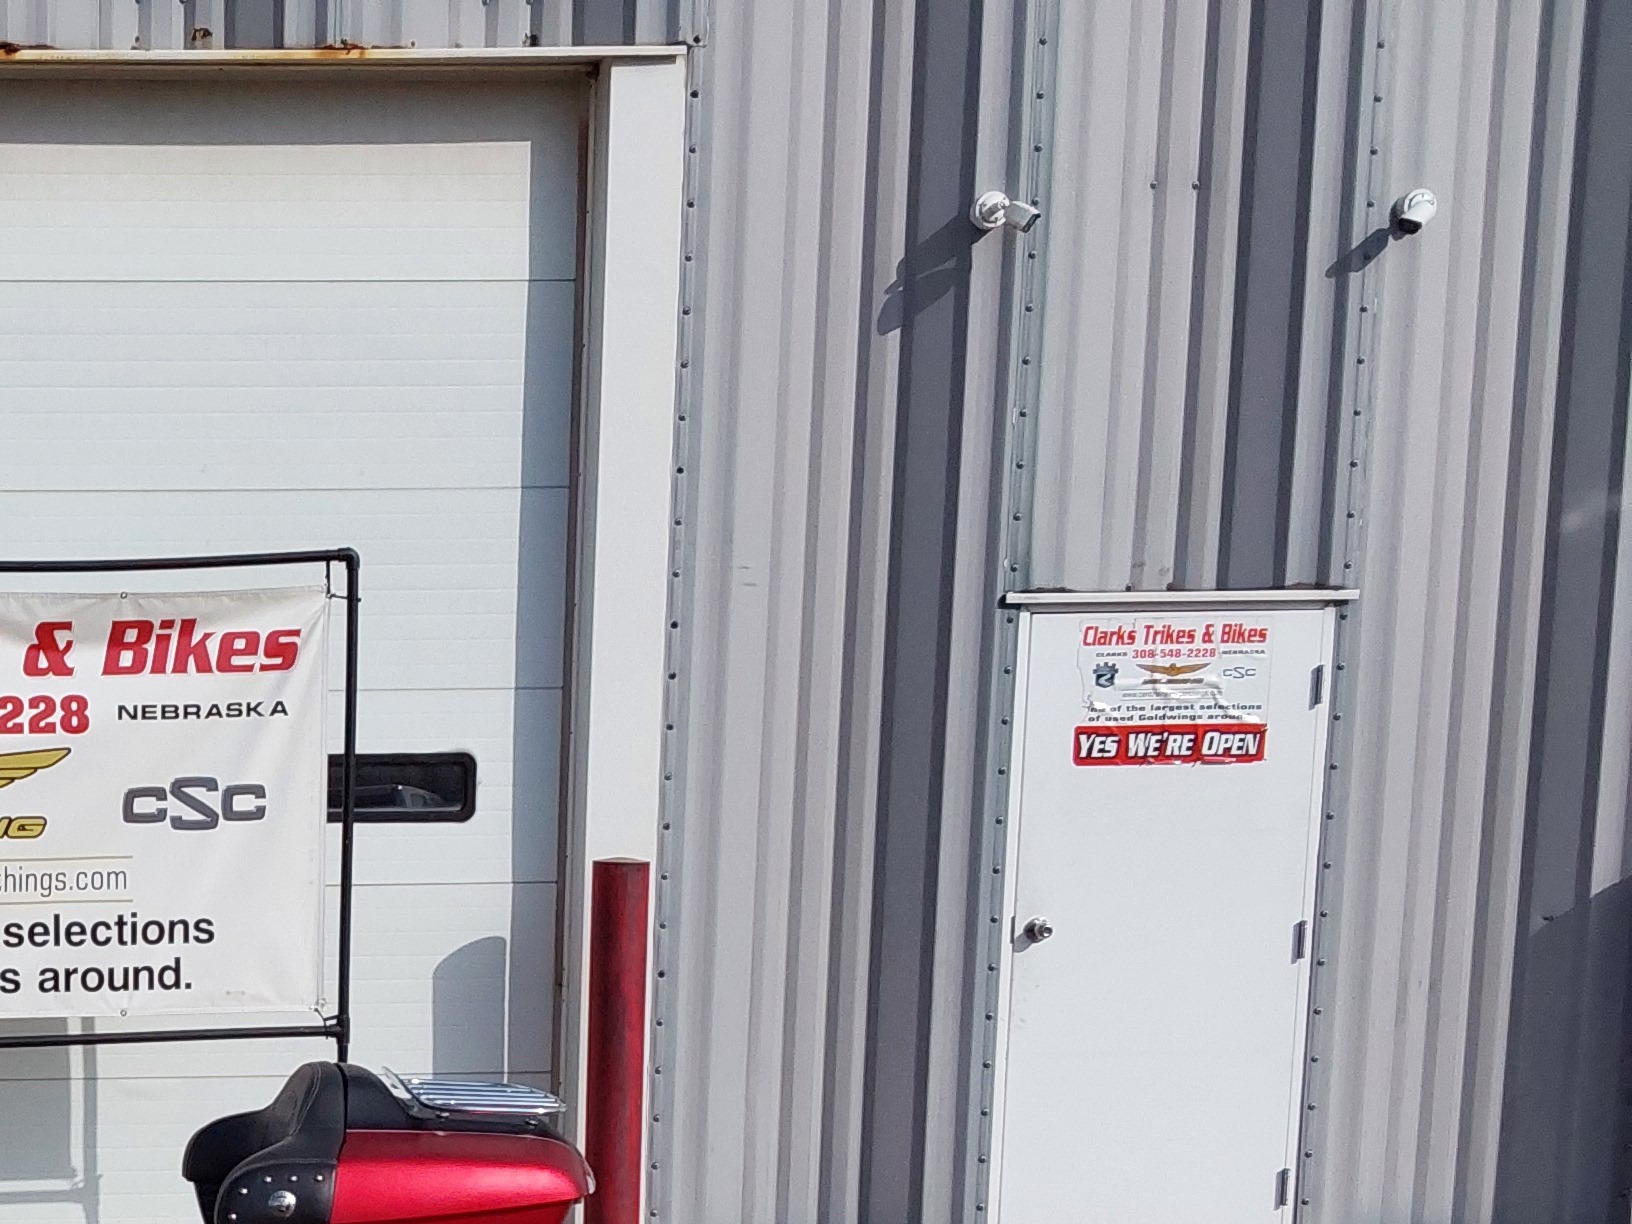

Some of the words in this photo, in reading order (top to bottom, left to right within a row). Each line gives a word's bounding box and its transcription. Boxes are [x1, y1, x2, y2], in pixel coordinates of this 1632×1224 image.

[1083, 625, 1137, 646] Clarks
[1144, 624, 1196, 645] Trikes
[1202, 624, 1215, 644] &
[1220, 623, 1268, 643] Bikes
[23, 620, 74, 678] &
[101, 617, 301, 676] Bikes
[1132, 648, 1216, 659] 308-548-2228
[117, 700, 289, 721] NEBRASKA
[1139, 713, 1203, 721] Goldwings
[1078, 733, 1121, 758] YES
[1128, 731, 1196, 757] WE'RE
[1201, 731, 1261, 755] OPEN
[2, 911, 216, 948] selections
[38, 956, 193, 993] around.
